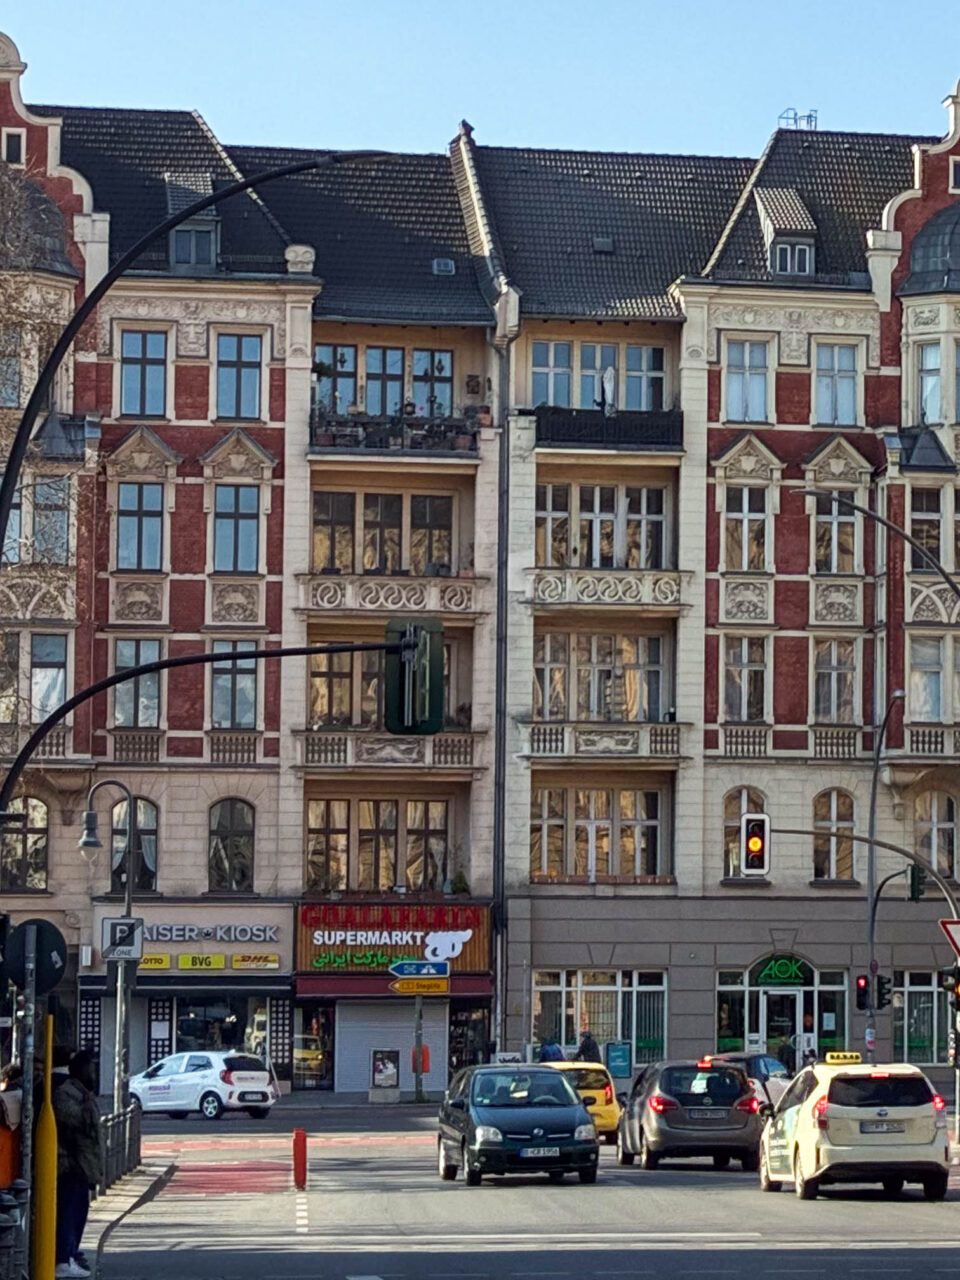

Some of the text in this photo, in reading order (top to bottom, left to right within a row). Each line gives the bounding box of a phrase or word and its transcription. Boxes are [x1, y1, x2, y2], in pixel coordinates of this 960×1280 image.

[116, 925, 129, 944] P
[143, 925, 279, 942] AISER KIOSK
[313, 930, 425, 946] SUPERMARKT
[191, 956, 212, 967] BVG
[760, 959, 804, 978] AOK
